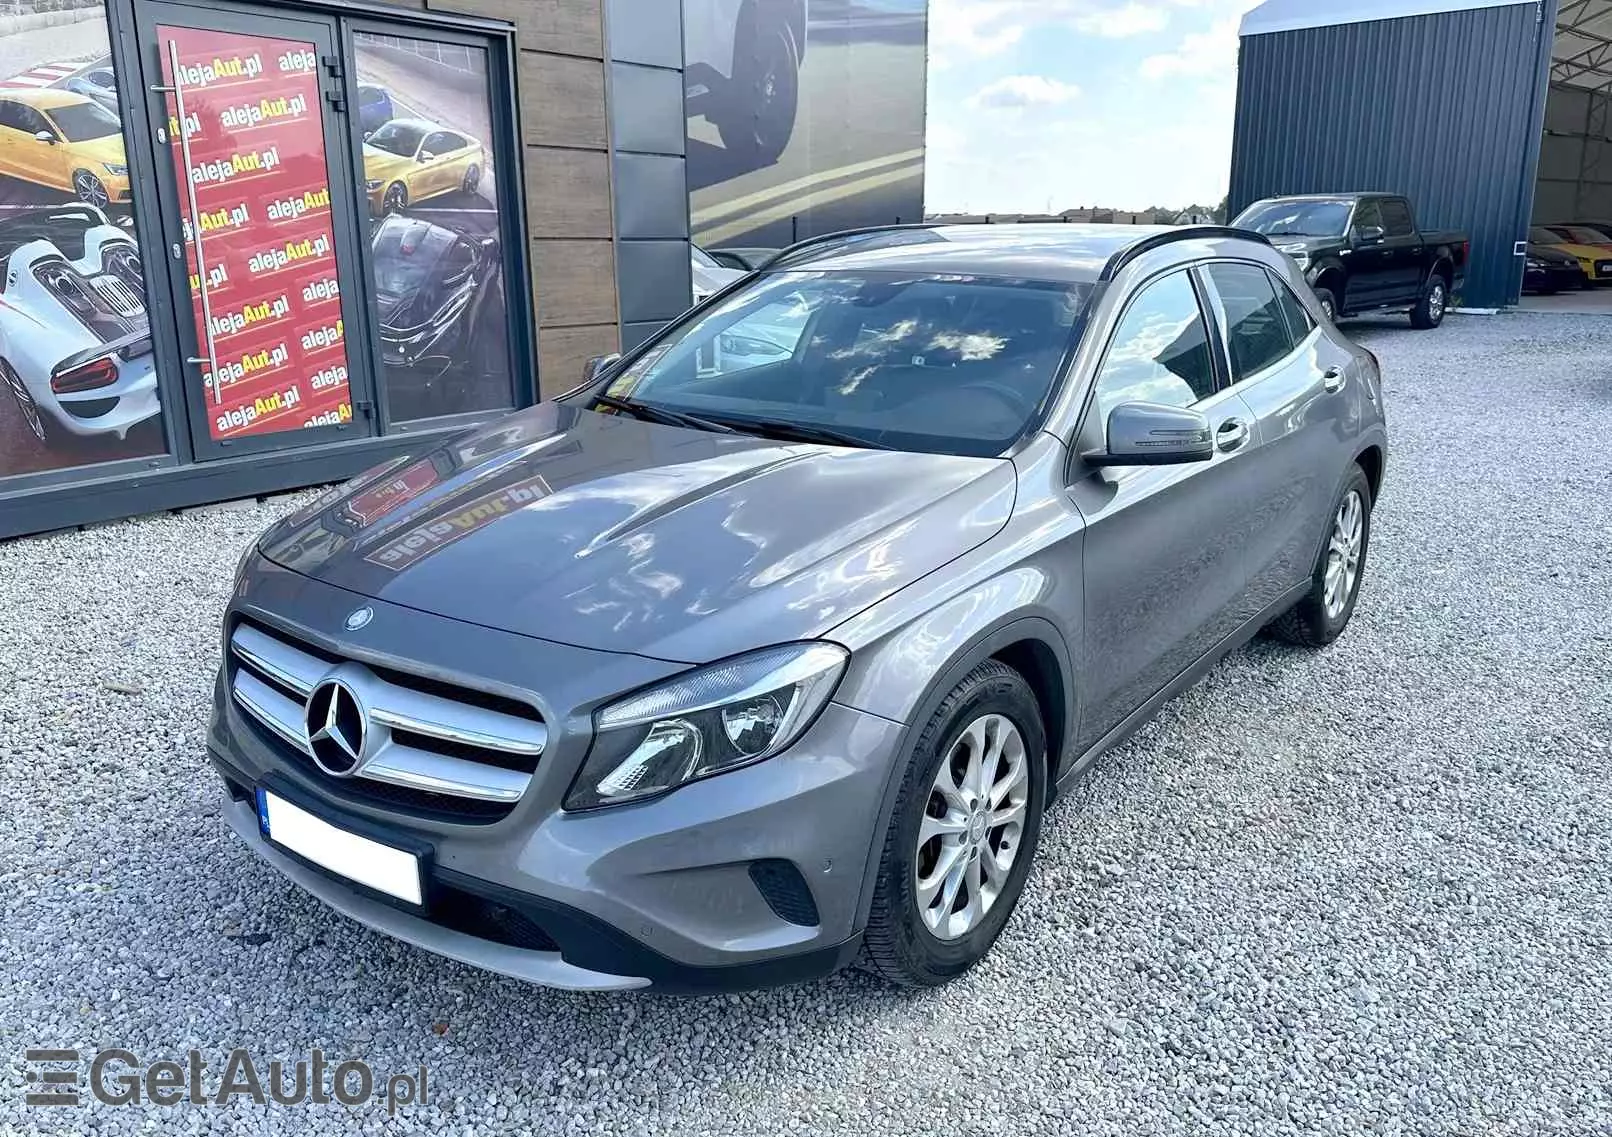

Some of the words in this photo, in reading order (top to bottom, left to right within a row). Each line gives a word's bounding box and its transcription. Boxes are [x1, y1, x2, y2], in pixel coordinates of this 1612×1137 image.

[221, 93, 307, 127] alejaAut.pl
[192, 147, 280, 184] alejaAut.pl
[248, 234, 330, 273] alejaAut.pl
[203, 343, 289, 388] aejaAut.pl
[216, 385, 300, 431] alejaAut.pl
